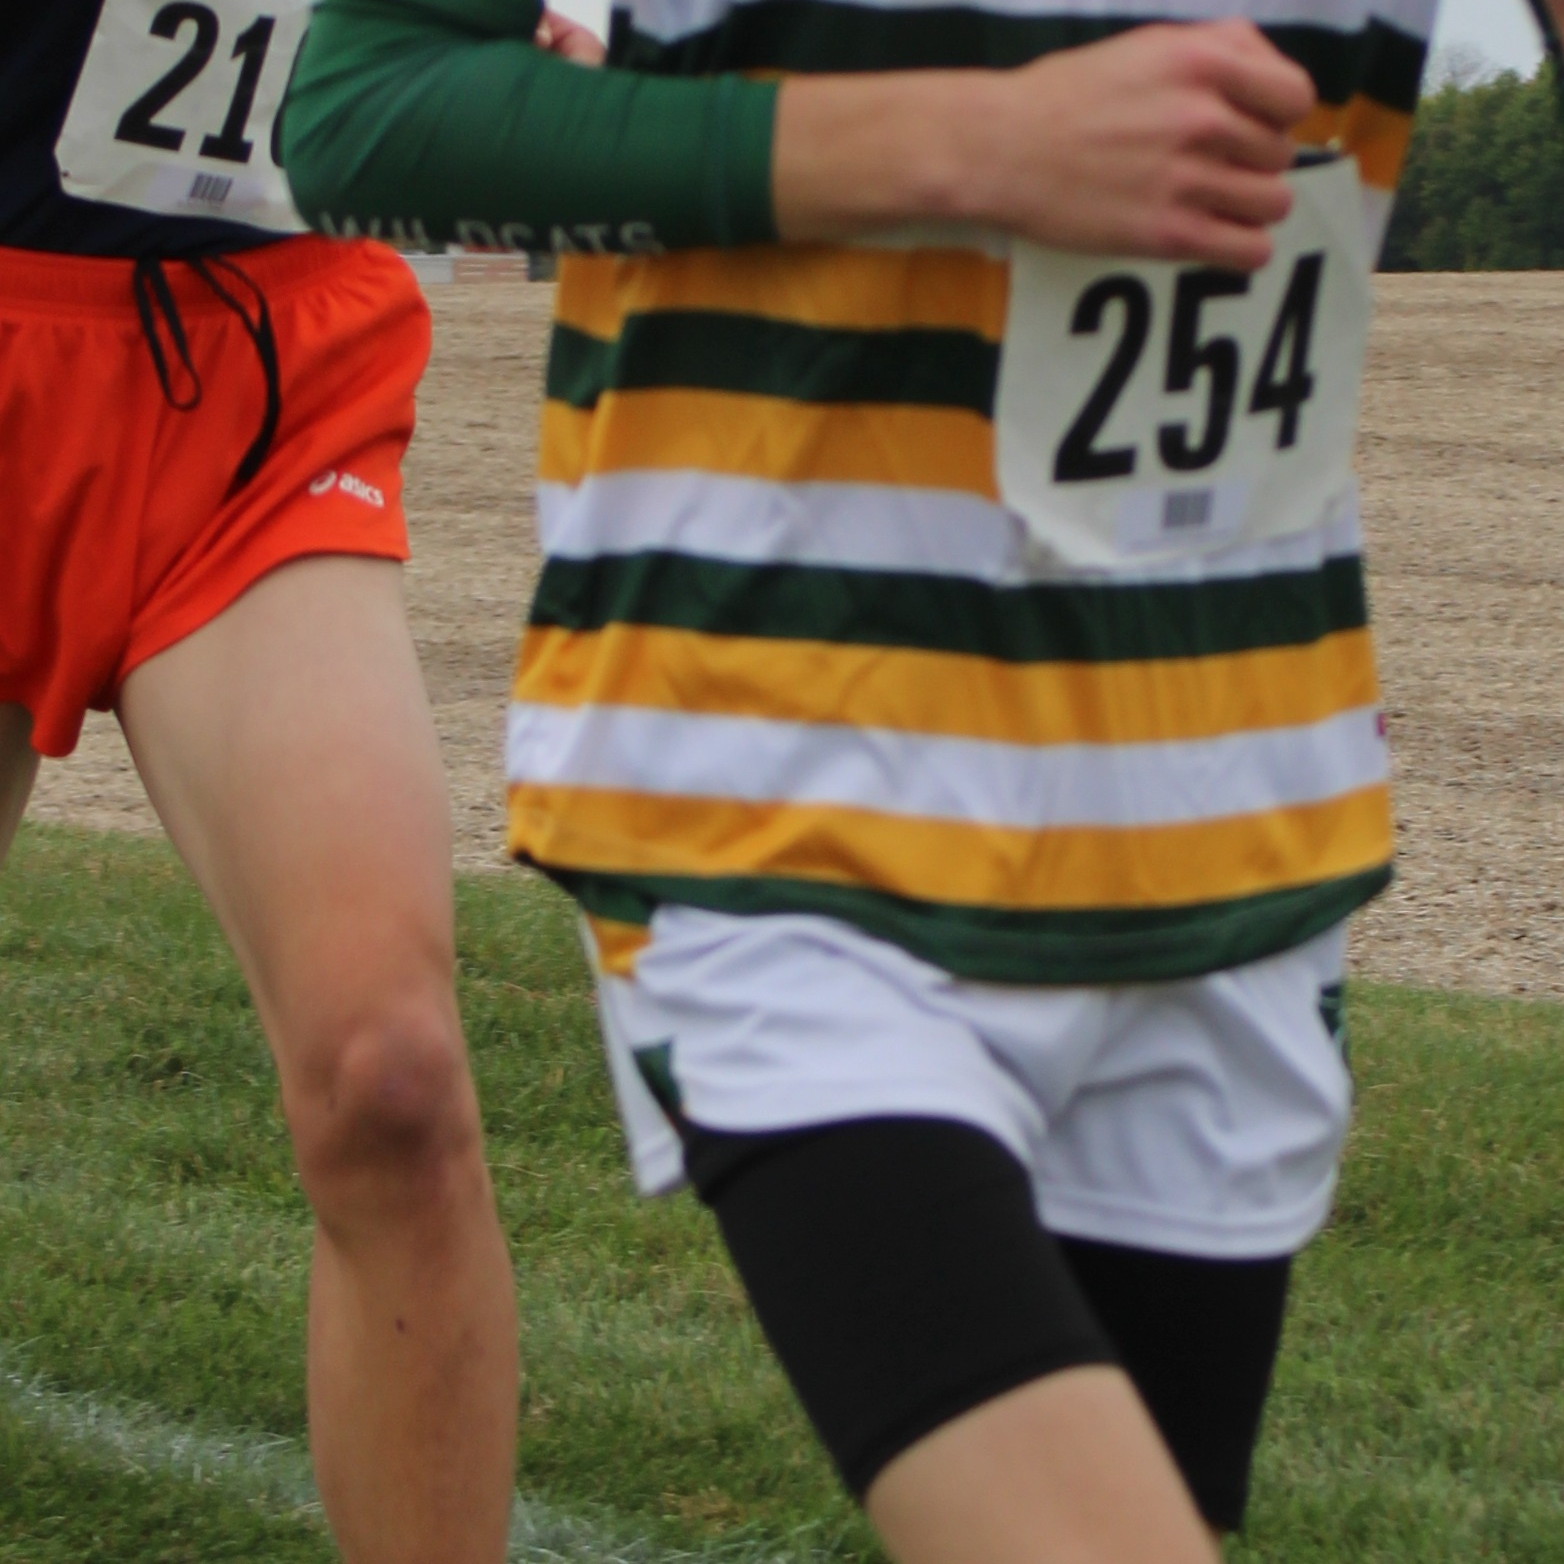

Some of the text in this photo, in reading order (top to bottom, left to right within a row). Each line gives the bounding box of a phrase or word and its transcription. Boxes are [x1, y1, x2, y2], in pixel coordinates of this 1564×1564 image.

[114, 0, 288, 169] 21
[1053, 249, 1326, 482] 254
[339, 472, 385, 509] asics
